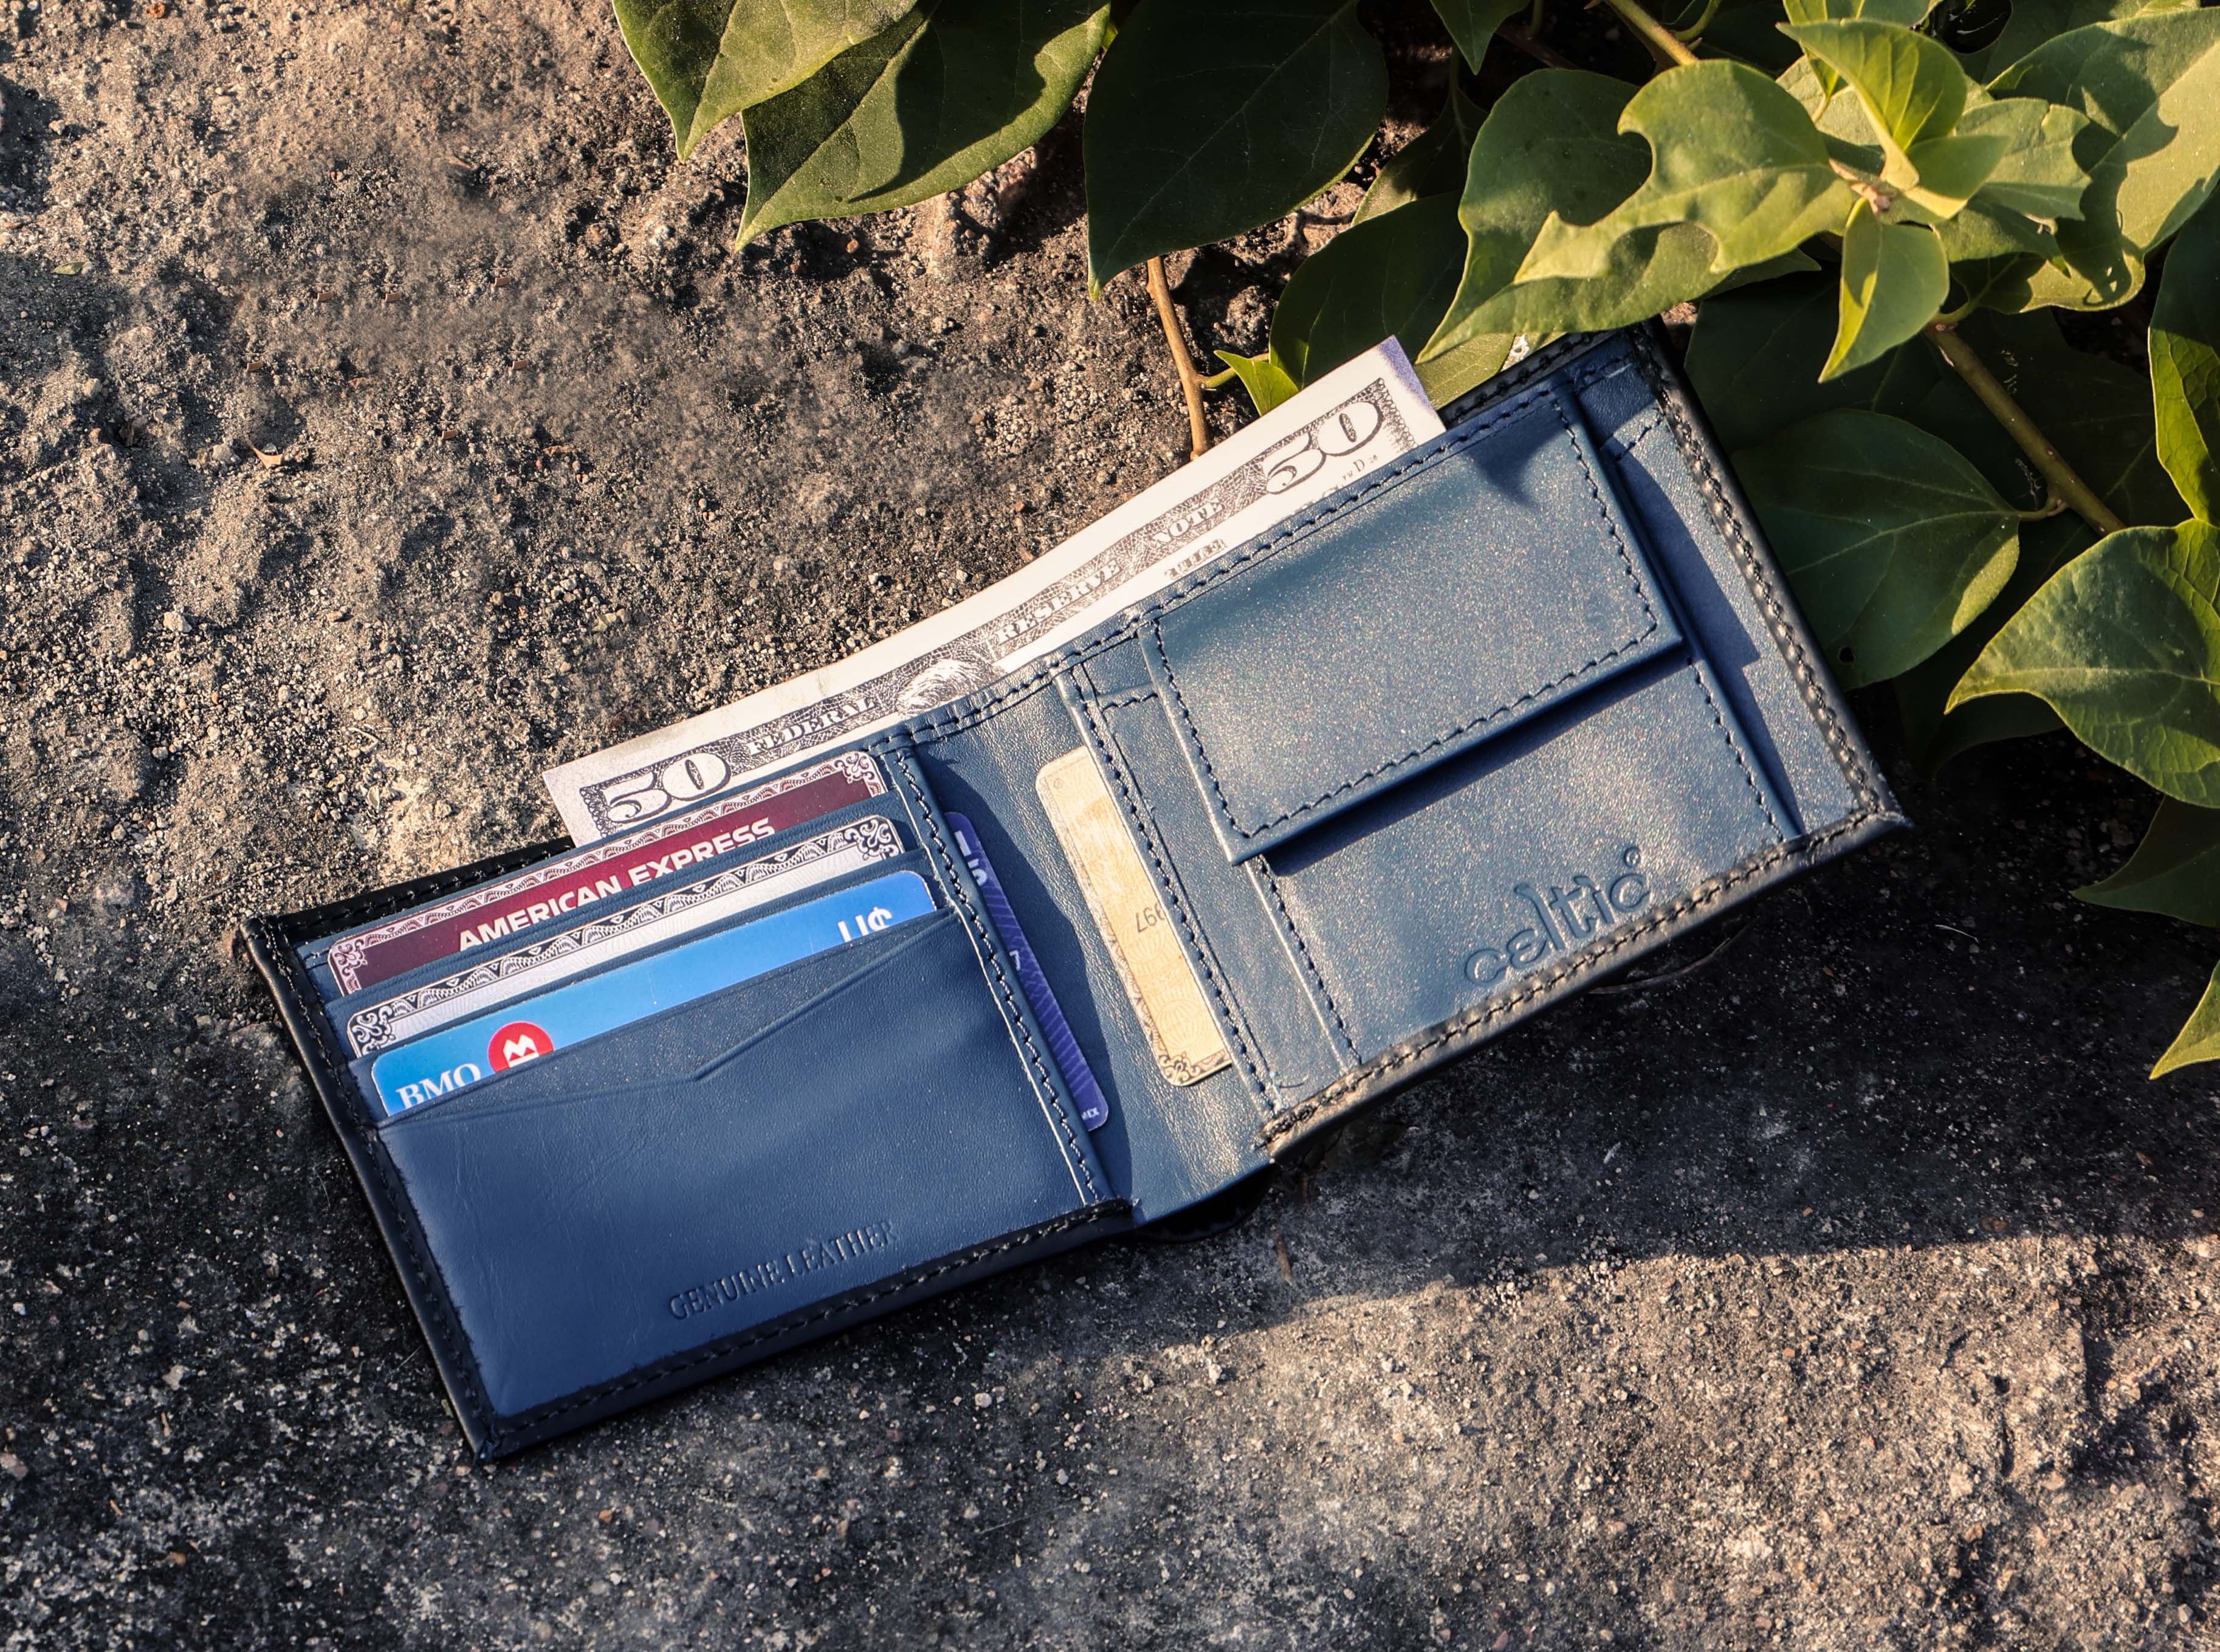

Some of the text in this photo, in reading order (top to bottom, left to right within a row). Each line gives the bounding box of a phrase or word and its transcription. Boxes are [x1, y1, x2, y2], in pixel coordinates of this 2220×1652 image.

[1261, 401, 1384, 495] 50
[746, 497, 1223, 755] FEDERAL RESERVE NOTE
[602, 752, 732, 824] 50
[460, 817, 775, 951] AMERICAN EXPRESS
[396, 1063, 481, 1109] BMO
[669, 1219, 899, 1321] GENUINE LEATHER
